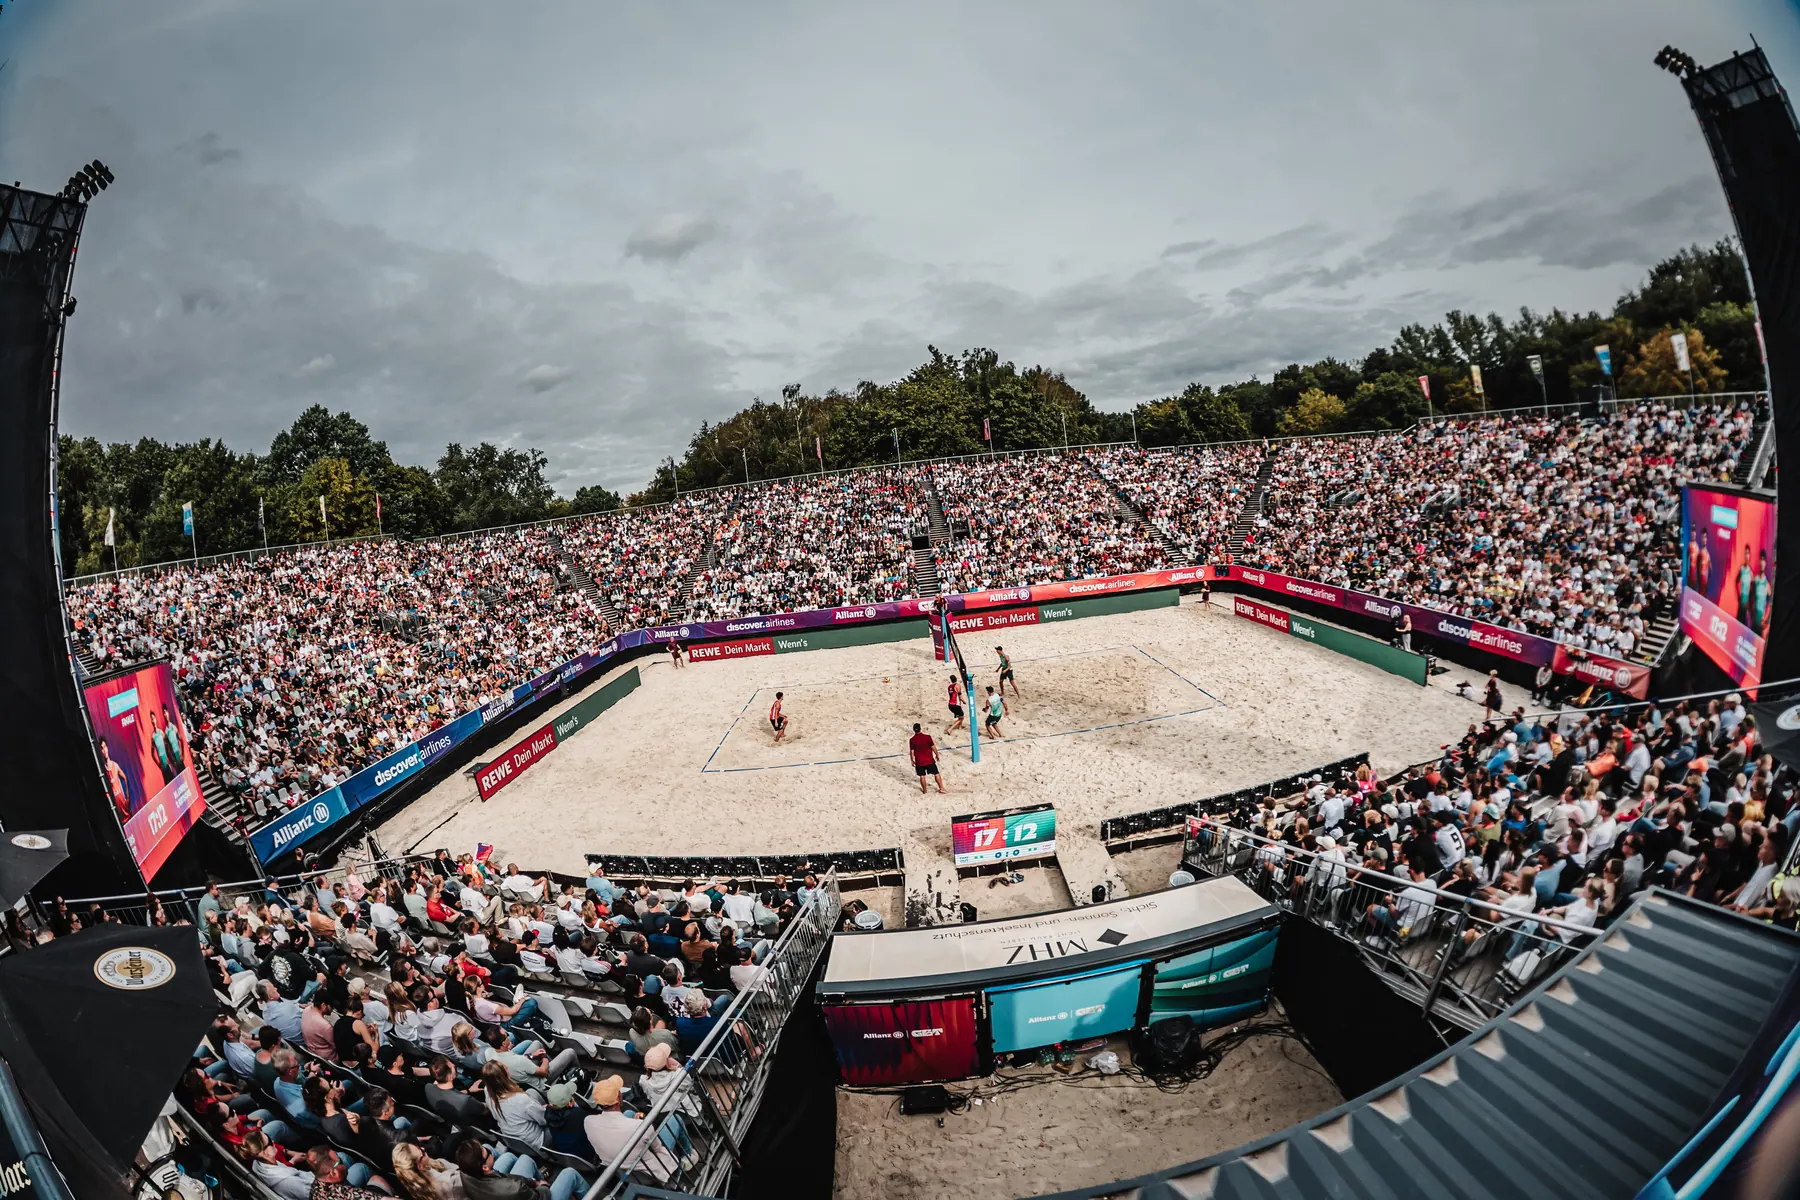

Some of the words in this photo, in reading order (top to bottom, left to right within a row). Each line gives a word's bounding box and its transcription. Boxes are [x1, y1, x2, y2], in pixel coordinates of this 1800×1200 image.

[1171, 570, 1195, 581] Allianz
[989, 590, 1018, 602] Allianz
[835, 610, 864, 620] Allianz
[1043, 608, 1073, 619] Wenn's
[1235, 602, 1254, 617] REWE
[1256, 608, 1268, 621] Dein
[1269, 613, 1288, 629] Markt
[1364, 600, 1390, 616] Allianz
[952, 618, 984, 630] REWE
[988, 615, 1008, 626] Dein
[1010, 612, 1036, 624] Markt
[1292, 620, 1315, 638] Wenn's
[654, 630, 680, 638] Allianz
[692, 646, 721, 658] REWE
[724, 645, 744, 655] Dein
[745, 642, 770, 652] Markt
[778, 638, 808, 650] Wenn's
[556, 716, 579, 737] Wenn's
[482, 760, 512, 792] REWE
[514, 749, 532, 768] Dein
[532, 734, 554, 756] Markt
[272, 814, 315, 848] Allianz
[974, 828, 999, 848] 17
[1014, 822, 1038, 842] 12
[1036, 919, 1061, 928] und
[1064, 910, 1118, 922] Sonnen-
[932, 920, 1032, 940] Insektenschutz
[1002, 938, 1088, 964] MHZ
[123, 951, 144, 986] Warsteiner
[1182, 979, 1207, 990] Allianz
[1028, 1015, 1056, 1024] Allianz
